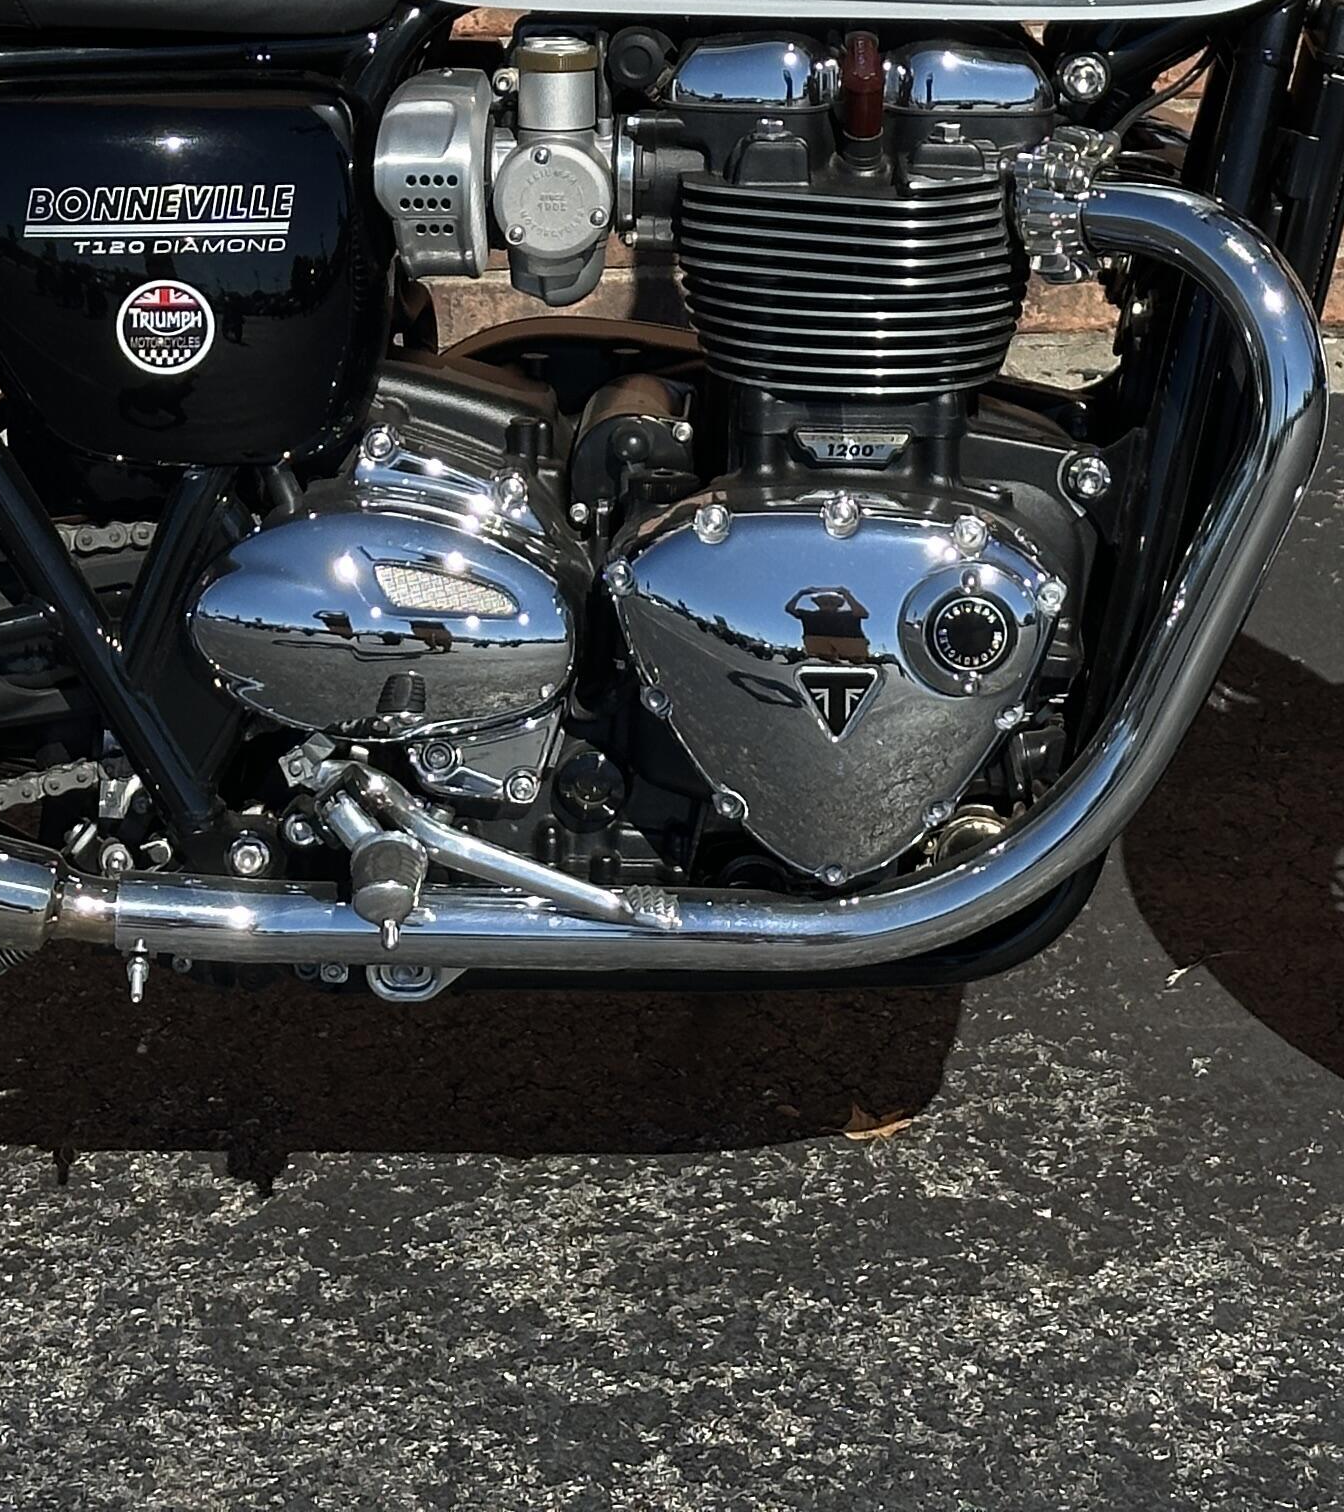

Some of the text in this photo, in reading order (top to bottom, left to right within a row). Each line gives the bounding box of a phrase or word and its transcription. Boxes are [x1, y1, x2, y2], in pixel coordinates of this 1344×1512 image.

[25, 184, 296, 222] BONNEVILLE
[73, 238, 287, 255] T120 DIAMOND
[128, 308, 203, 336] TRIUMPH
[129, 336, 201, 349] MOTORCYCLES
[827, 444, 875, 458] 1200
